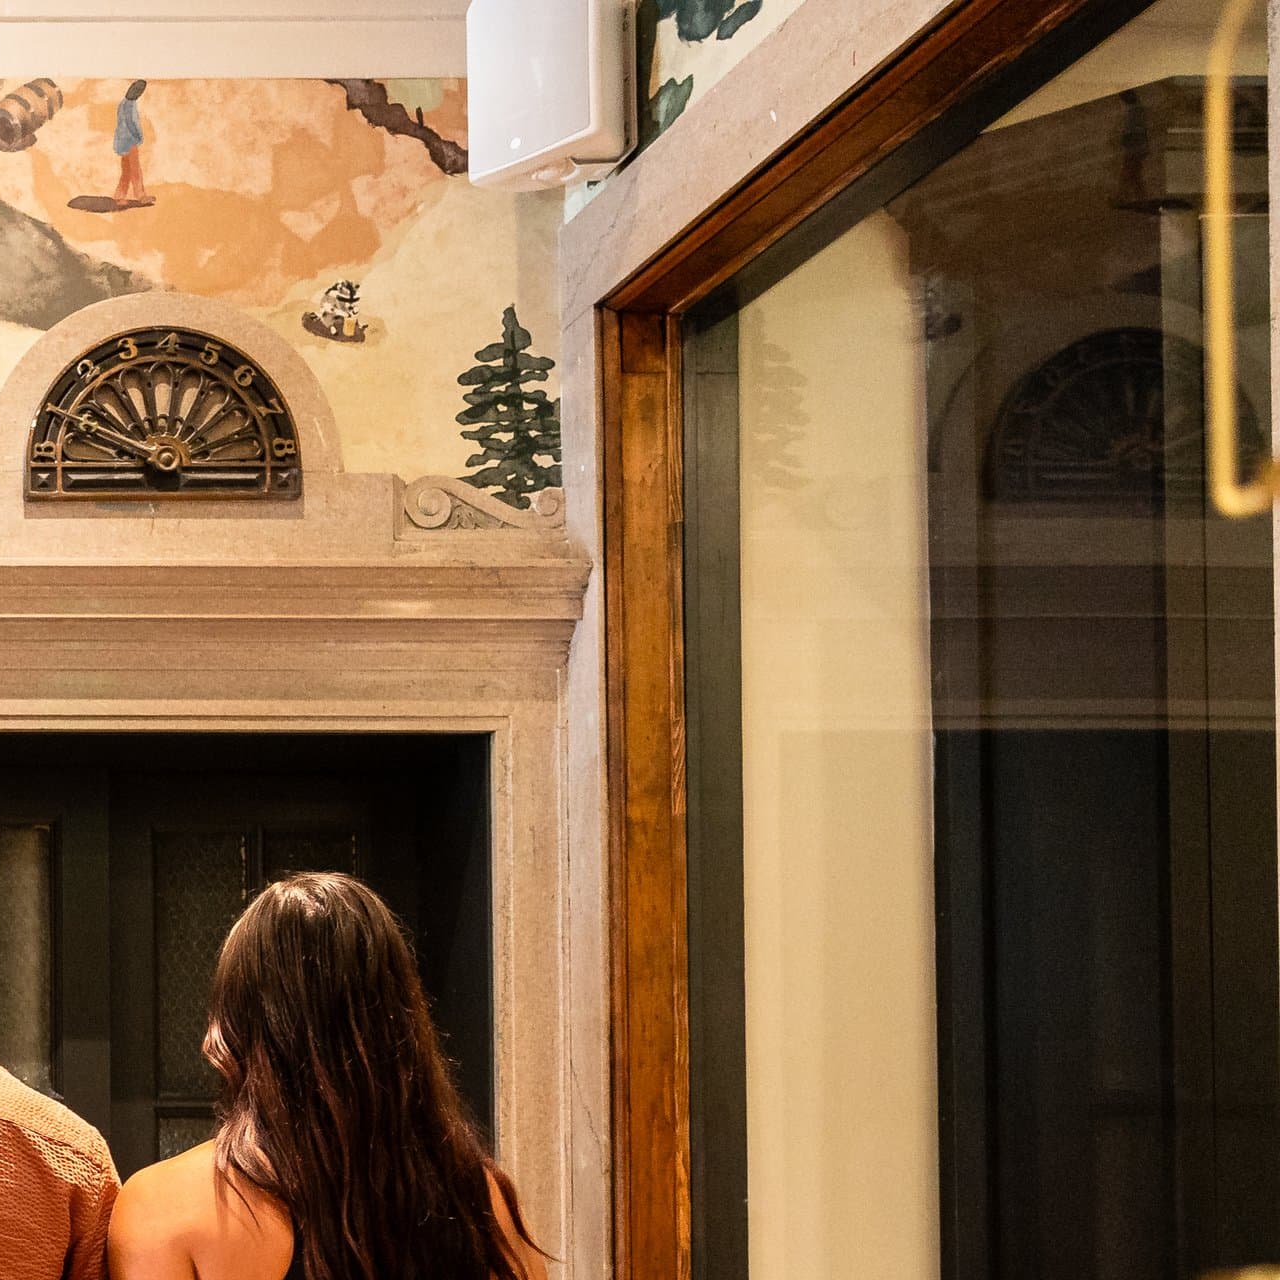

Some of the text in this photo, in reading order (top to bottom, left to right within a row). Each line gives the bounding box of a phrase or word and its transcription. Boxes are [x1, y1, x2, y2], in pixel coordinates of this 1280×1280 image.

[76, 359, 100, 384] 2
[117, 337, 138, 360] 3
[155, 332, 180, 355] 4
[199, 342, 222, 365] 5
[233, 365, 256, 386] 6
[257, 398, 284, 417] 7
